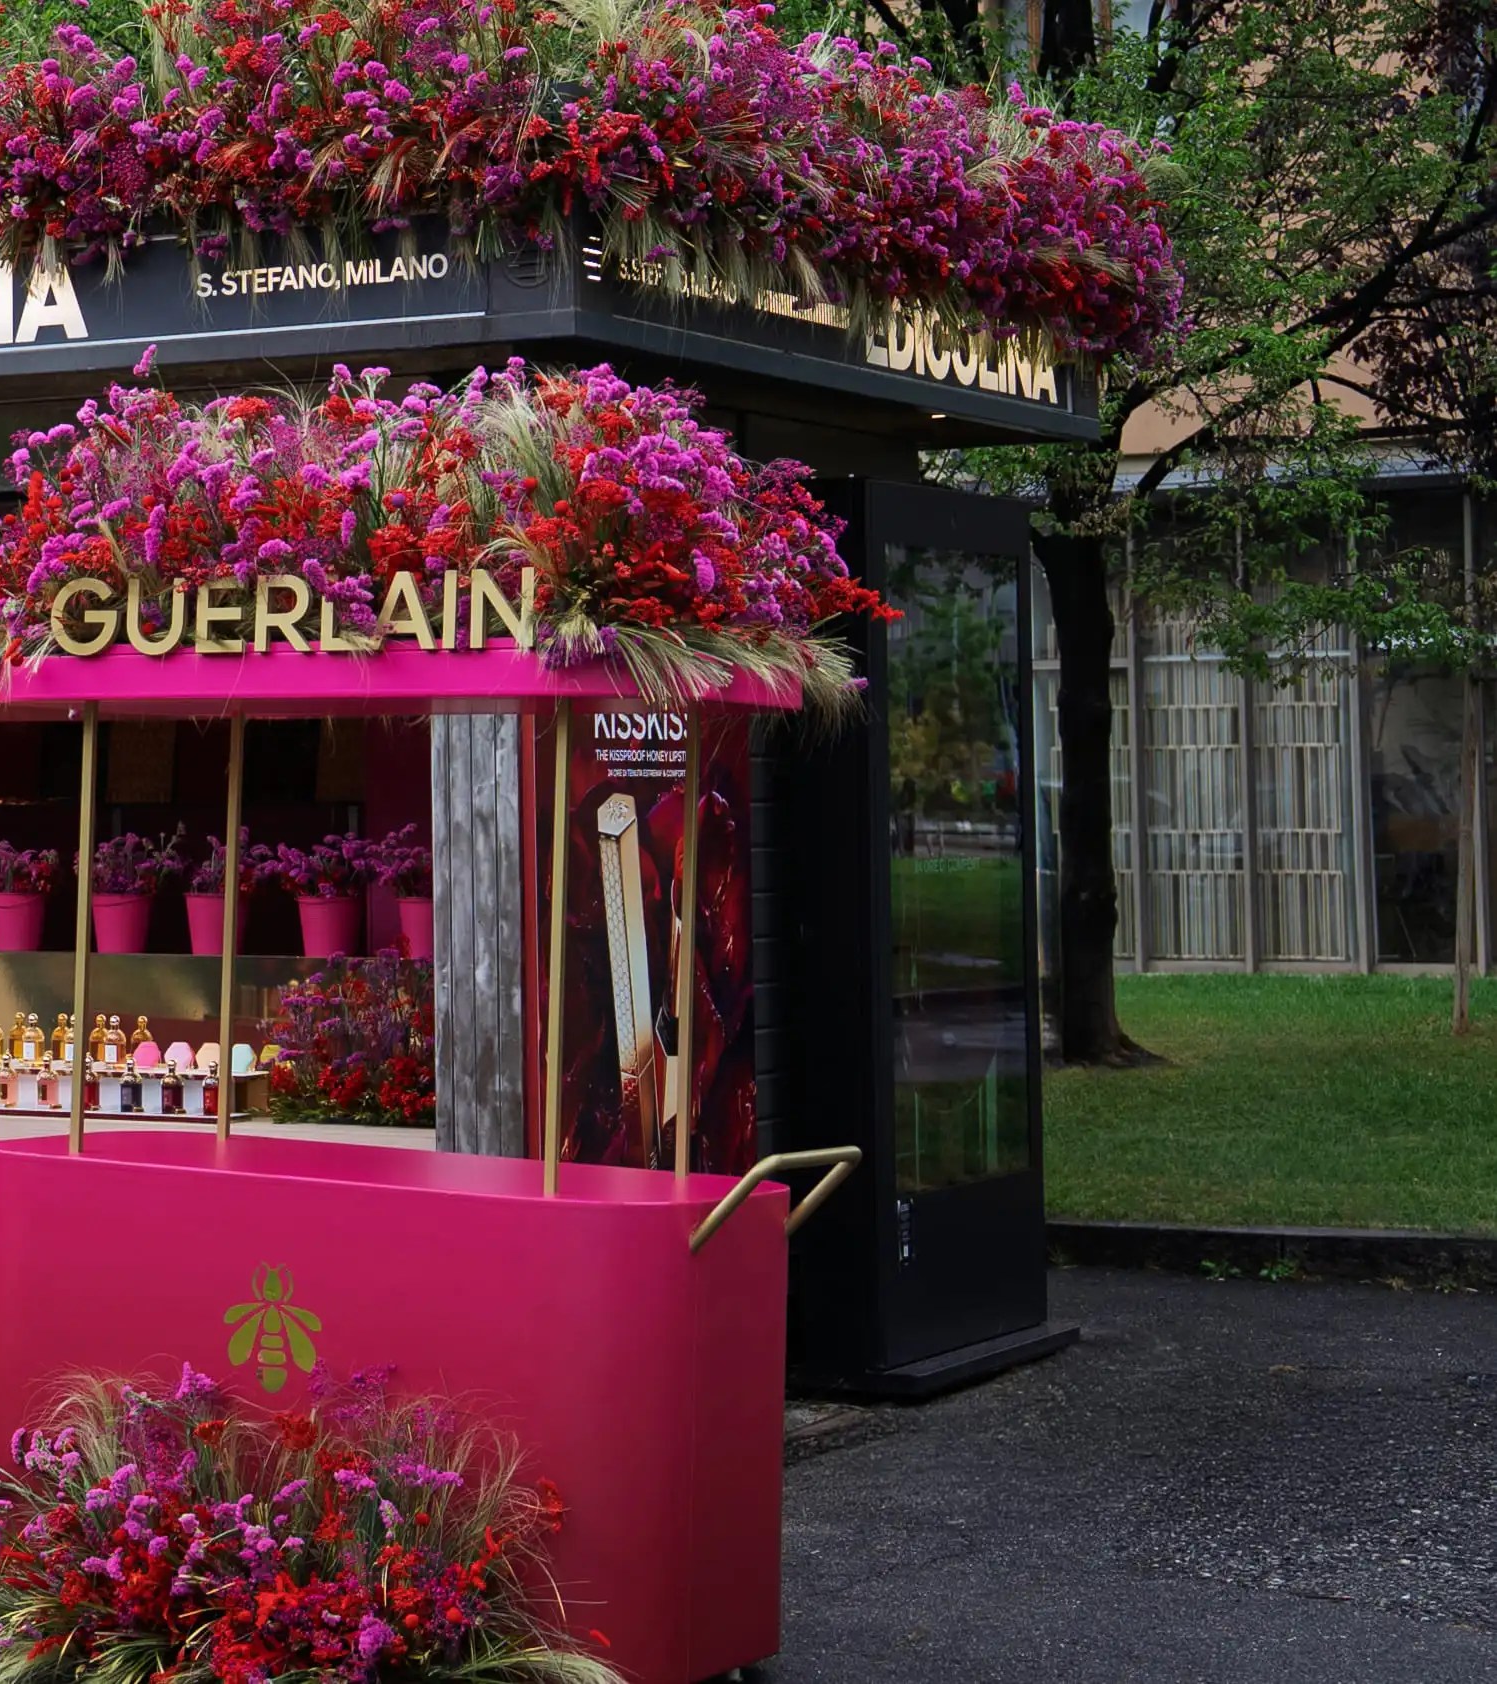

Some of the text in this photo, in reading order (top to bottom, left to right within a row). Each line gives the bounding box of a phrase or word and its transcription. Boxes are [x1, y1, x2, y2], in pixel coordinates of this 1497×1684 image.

[196, 253, 449, 298] S. STEFANO, MILANO
[50, 566, 536, 657] GUERLAIN
[595, 748, 609, 762] THE
[646, 749, 668, 763] HONEY
